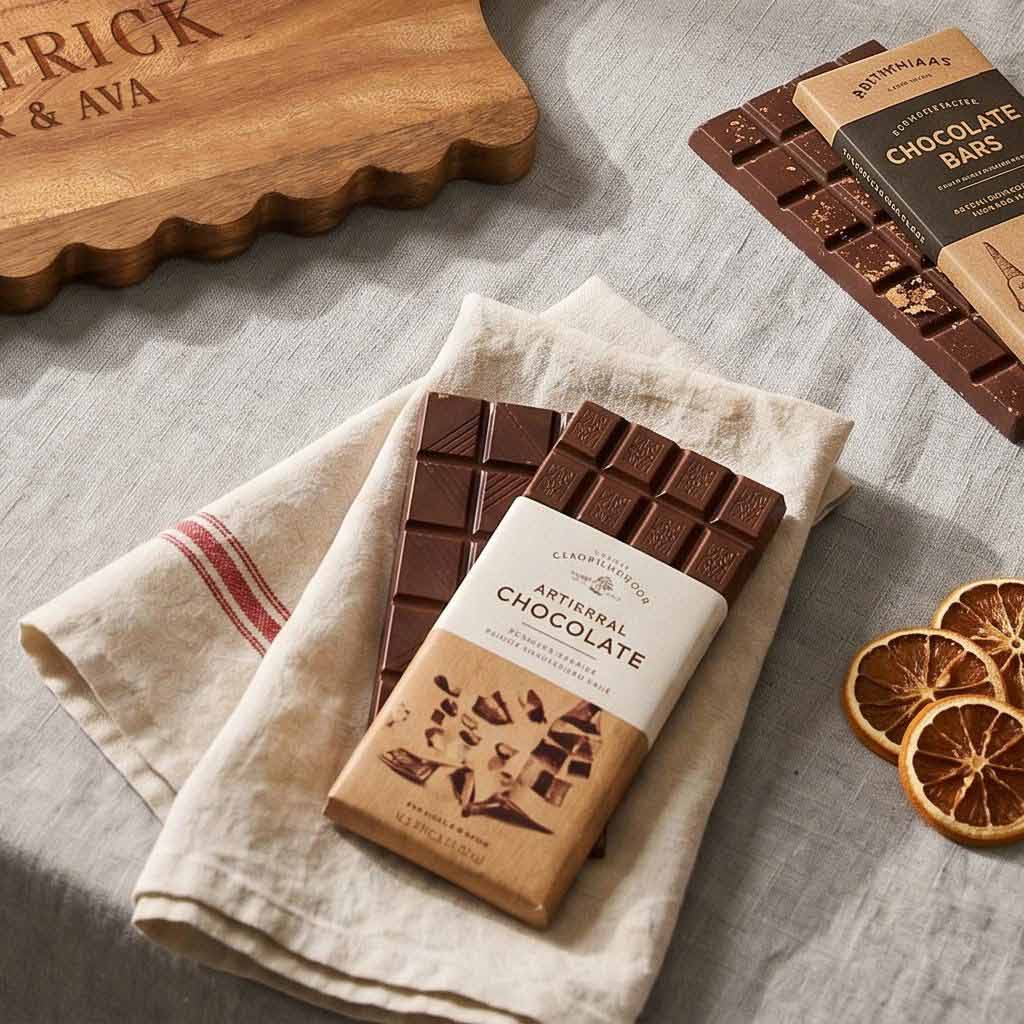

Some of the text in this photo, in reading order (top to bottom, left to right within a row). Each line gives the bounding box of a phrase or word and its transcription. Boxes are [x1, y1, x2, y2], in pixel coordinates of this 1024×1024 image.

[28, 100, 63, 130] &
[79, 77, 160, 121] AVA
[885, 103, 1022, 165] CHOCOLATE
[938, 134, 1005, 170] BARS
[496, 585, 647, 671] CHOCOLATE
